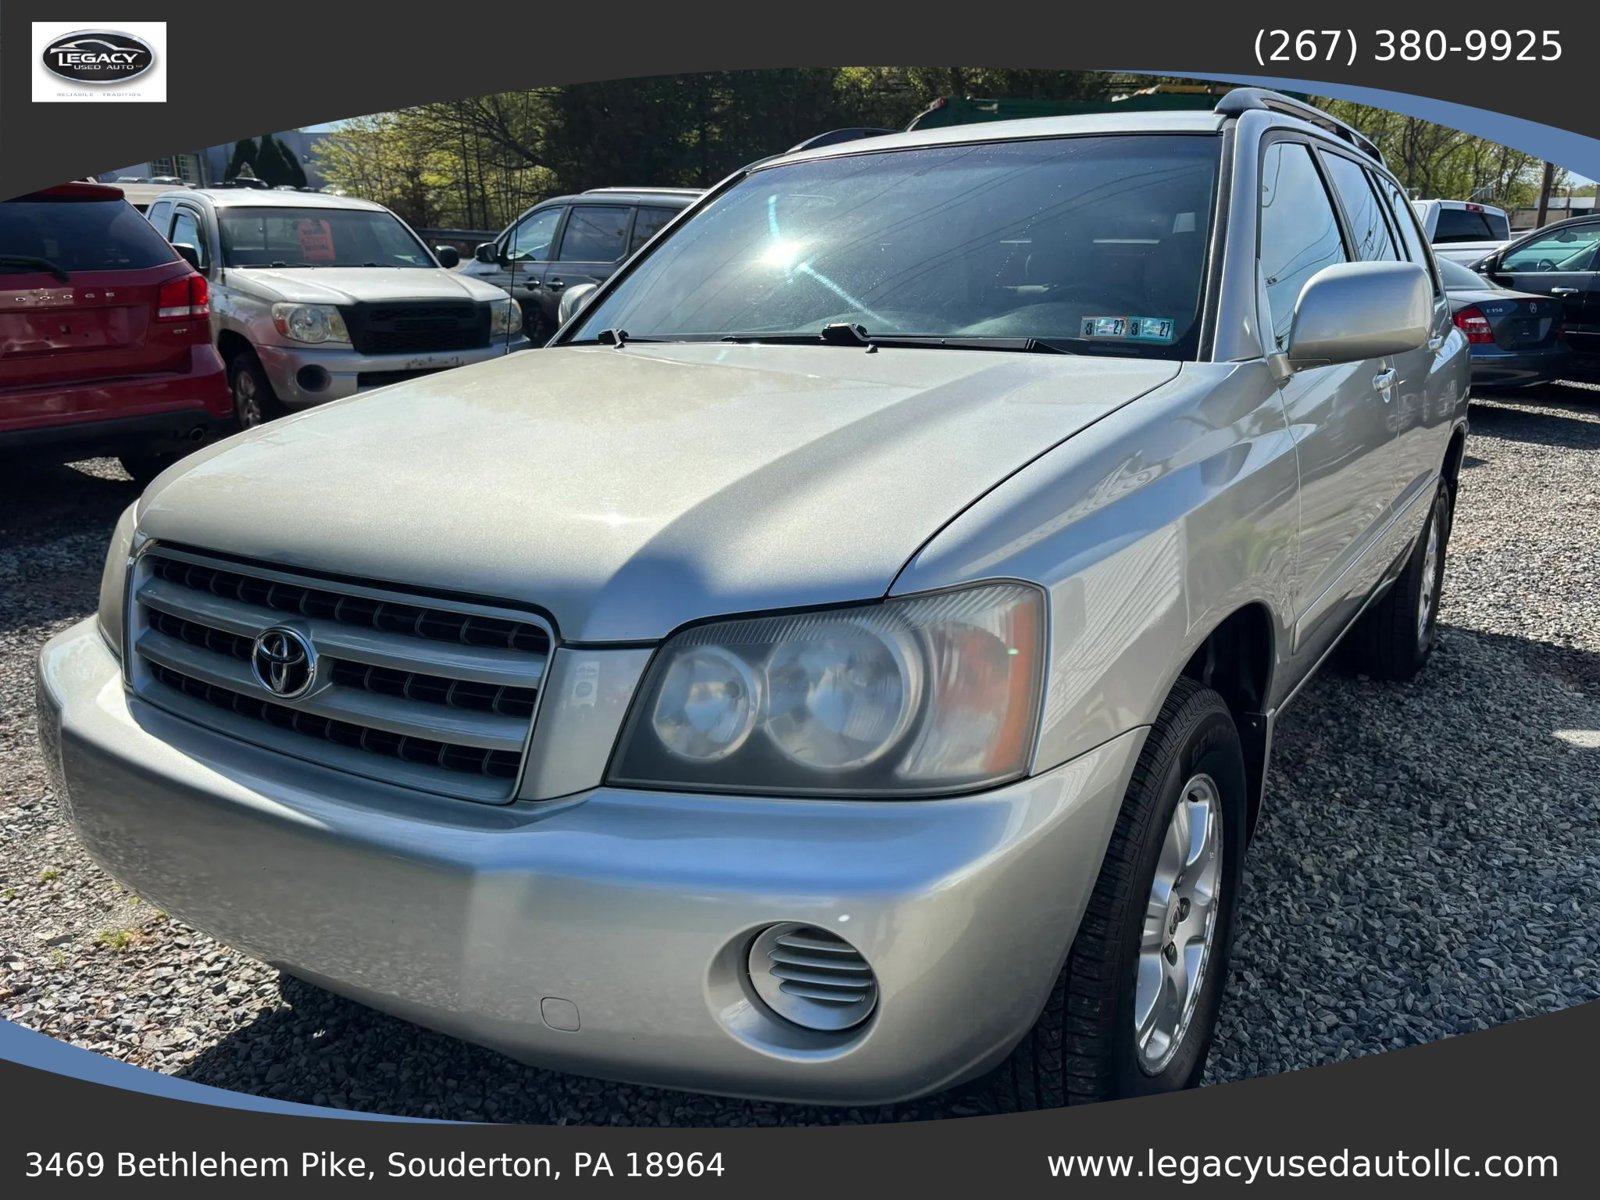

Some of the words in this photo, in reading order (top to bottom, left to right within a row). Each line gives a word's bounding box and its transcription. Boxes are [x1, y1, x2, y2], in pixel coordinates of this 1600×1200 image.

[15, 291, 116, 302] DODGE
[1085, 322, 1093, 336] 3
[1113, 319, 1125, 335] 27
[1131, 322, 1139, 336] 3
[1159, 321, 1171, 337] 27
